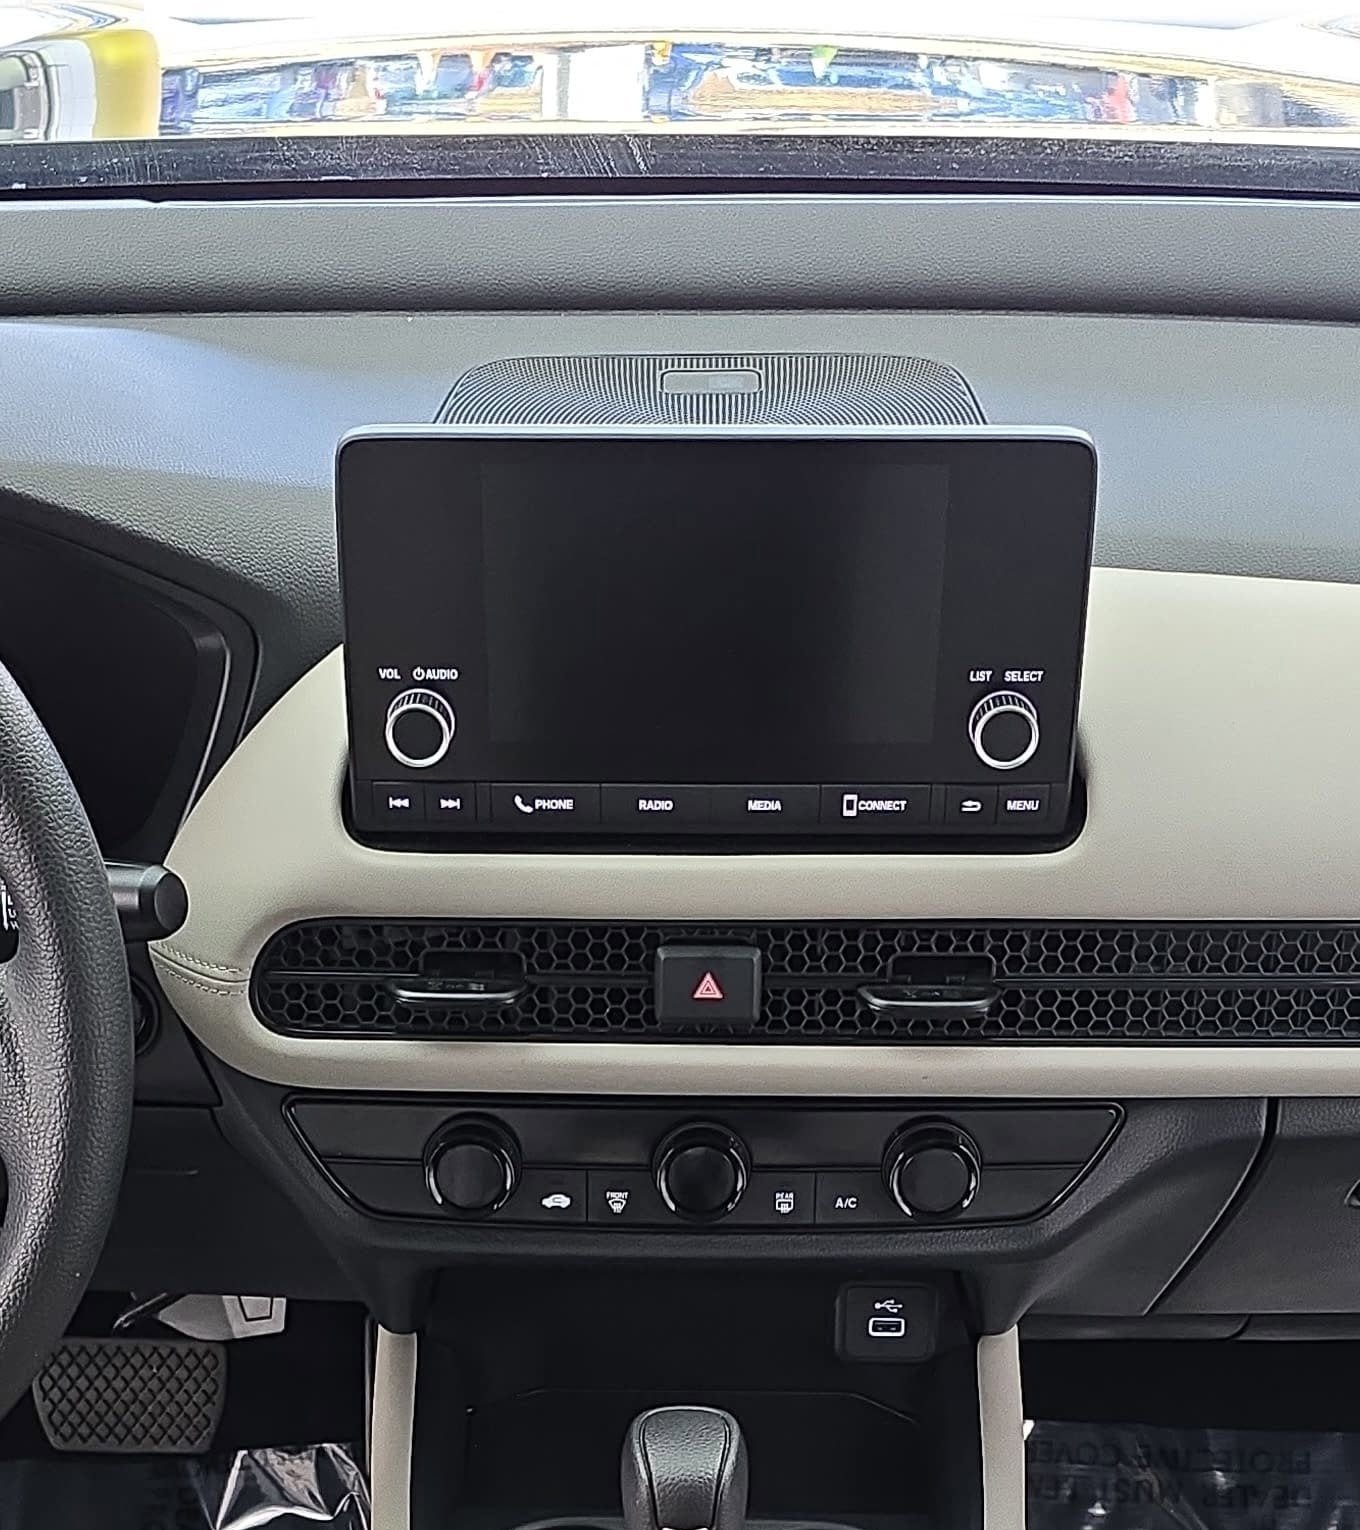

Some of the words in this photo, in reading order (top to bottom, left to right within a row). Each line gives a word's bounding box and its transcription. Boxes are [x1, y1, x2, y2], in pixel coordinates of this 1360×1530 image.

[378, 667, 401, 680] VOL
[425, 668, 459, 680] AUDIO
[969, 670, 993, 682] LIST
[1003, 670, 1044, 682] SELECT
[534, 799, 574, 810] PHONE
[638, 799, 673, 811] RADIO
[747, 799, 782, 811] MEDIA
[858, 799, 907, 811] CONNECT
[1006, 800, 1040, 811] MENU
[606, 1191, 629, 1200] FRONT
[775, 1192, 794, 1200] REAR
[834, 1197, 857, 1209] A/C
